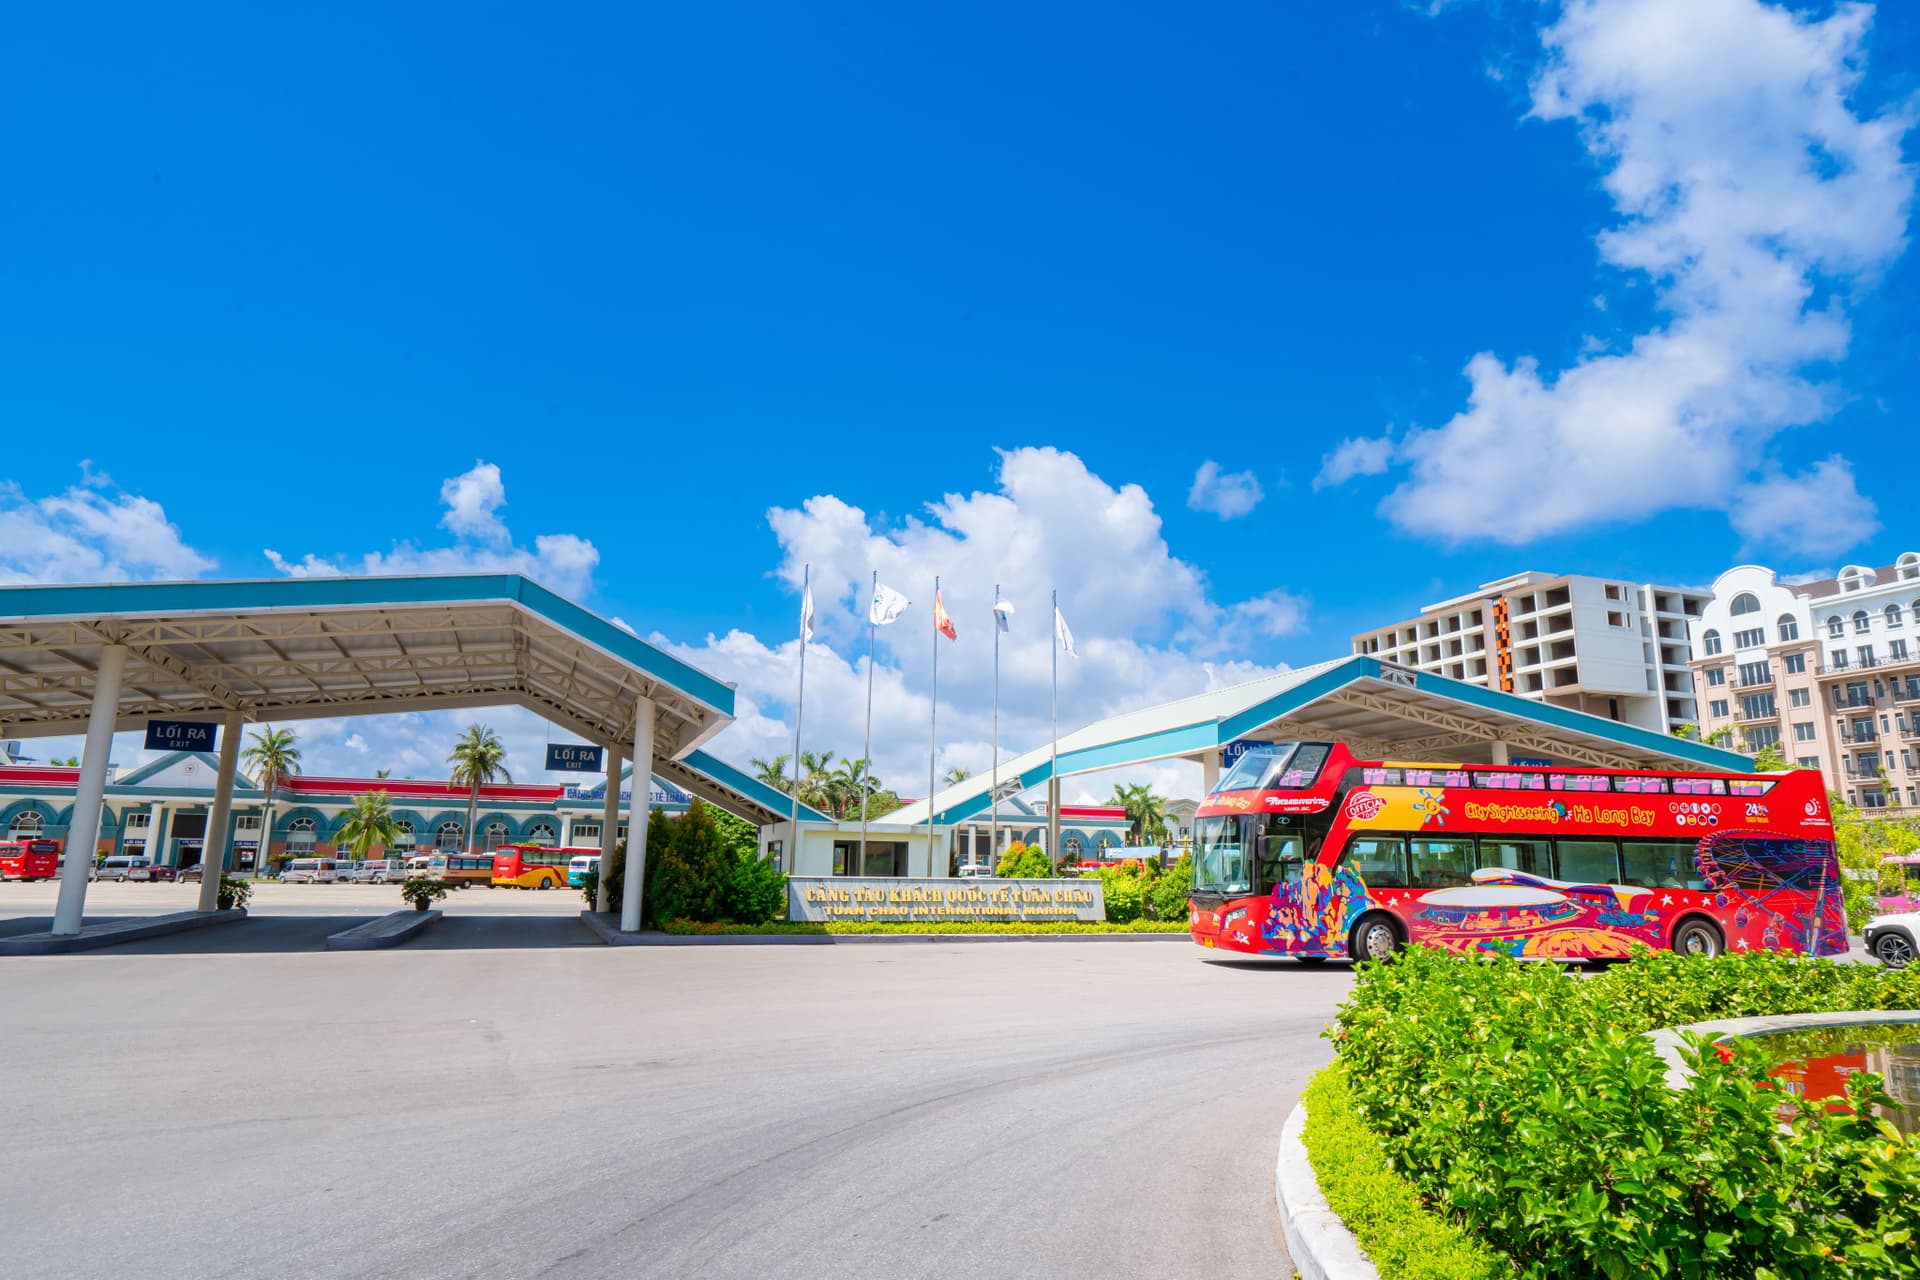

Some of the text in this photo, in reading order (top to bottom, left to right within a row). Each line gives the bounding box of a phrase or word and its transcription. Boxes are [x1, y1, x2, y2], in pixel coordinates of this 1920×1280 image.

[156, 724, 207, 740] LỐI RA
[554, 747, 596, 761] LỐI RA
[566, 761, 582, 769] EXIT
[1350, 799, 1383, 816] OFFICIAL
[1573, 805, 1656, 827] Ha Long Bay
[806, 884, 849, 902] CẢNG
[854, 886, 885, 902] TÀU
[889, 886, 943, 902] KHÁCH
[947, 886, 986, 903] QUỐC
[990, 886, 1009, 903] TẾ
[825, 906, 1076, 915] TUAN CHAU INTERNATIONAL MARINA
